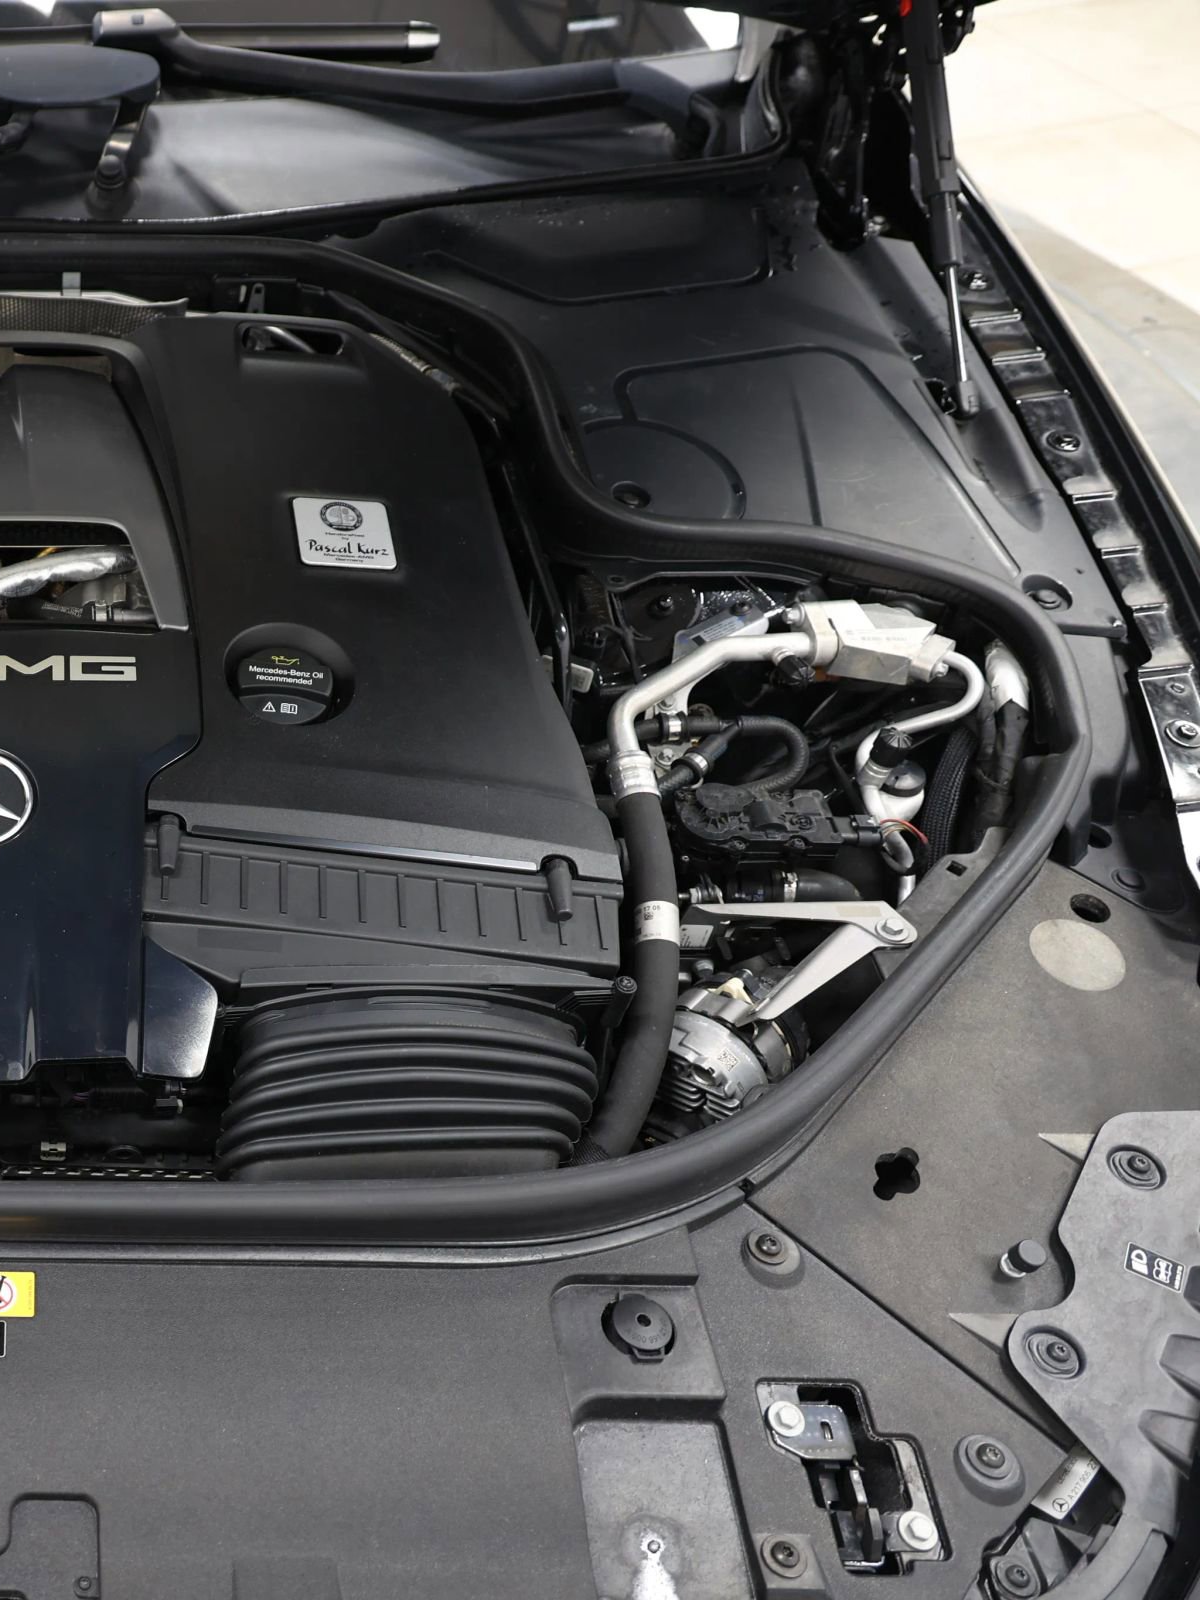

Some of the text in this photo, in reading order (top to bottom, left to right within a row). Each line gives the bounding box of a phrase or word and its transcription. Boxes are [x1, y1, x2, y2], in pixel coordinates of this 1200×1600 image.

[305, 539, 353, 554] Pascal
[357, 542, 389, 556] Kurz
[249, 665, 324, 679] Mercedes-Benz Oil
[256, 674, 313, 685] recommended
